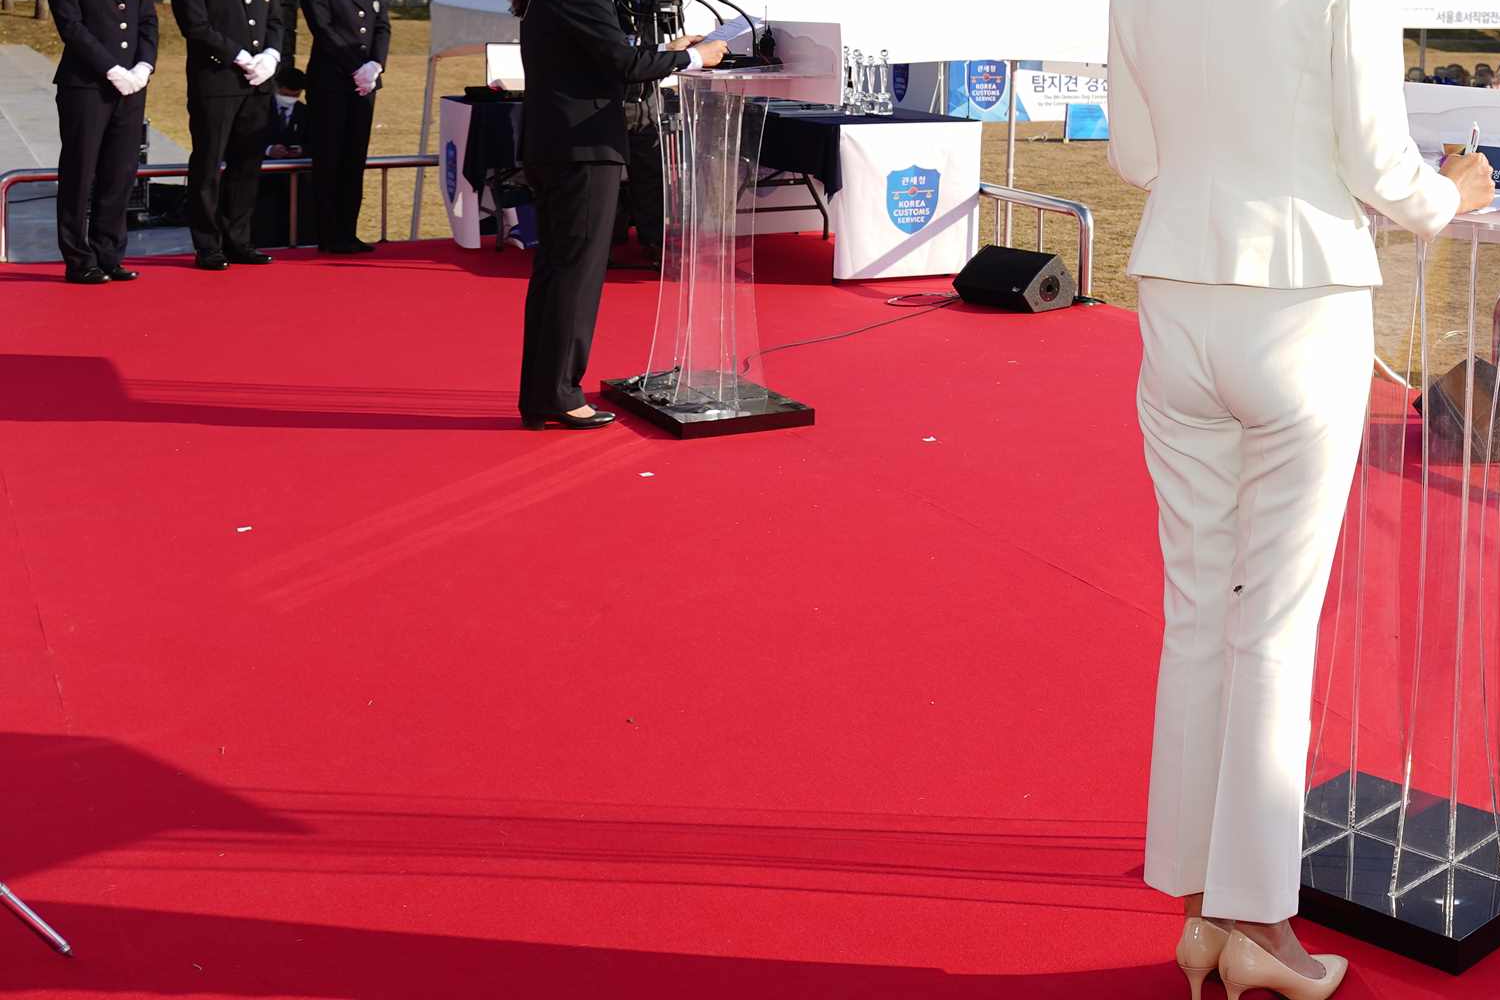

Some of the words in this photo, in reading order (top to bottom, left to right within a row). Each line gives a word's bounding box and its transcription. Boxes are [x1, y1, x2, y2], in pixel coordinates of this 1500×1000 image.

[1032, 74, 1078, 93] 탐지견
[898, 199, 926, 208] KOREA
[893, 208, 930, 217] CUSTOMS
[897, 215, 925, 224] SERVICE
